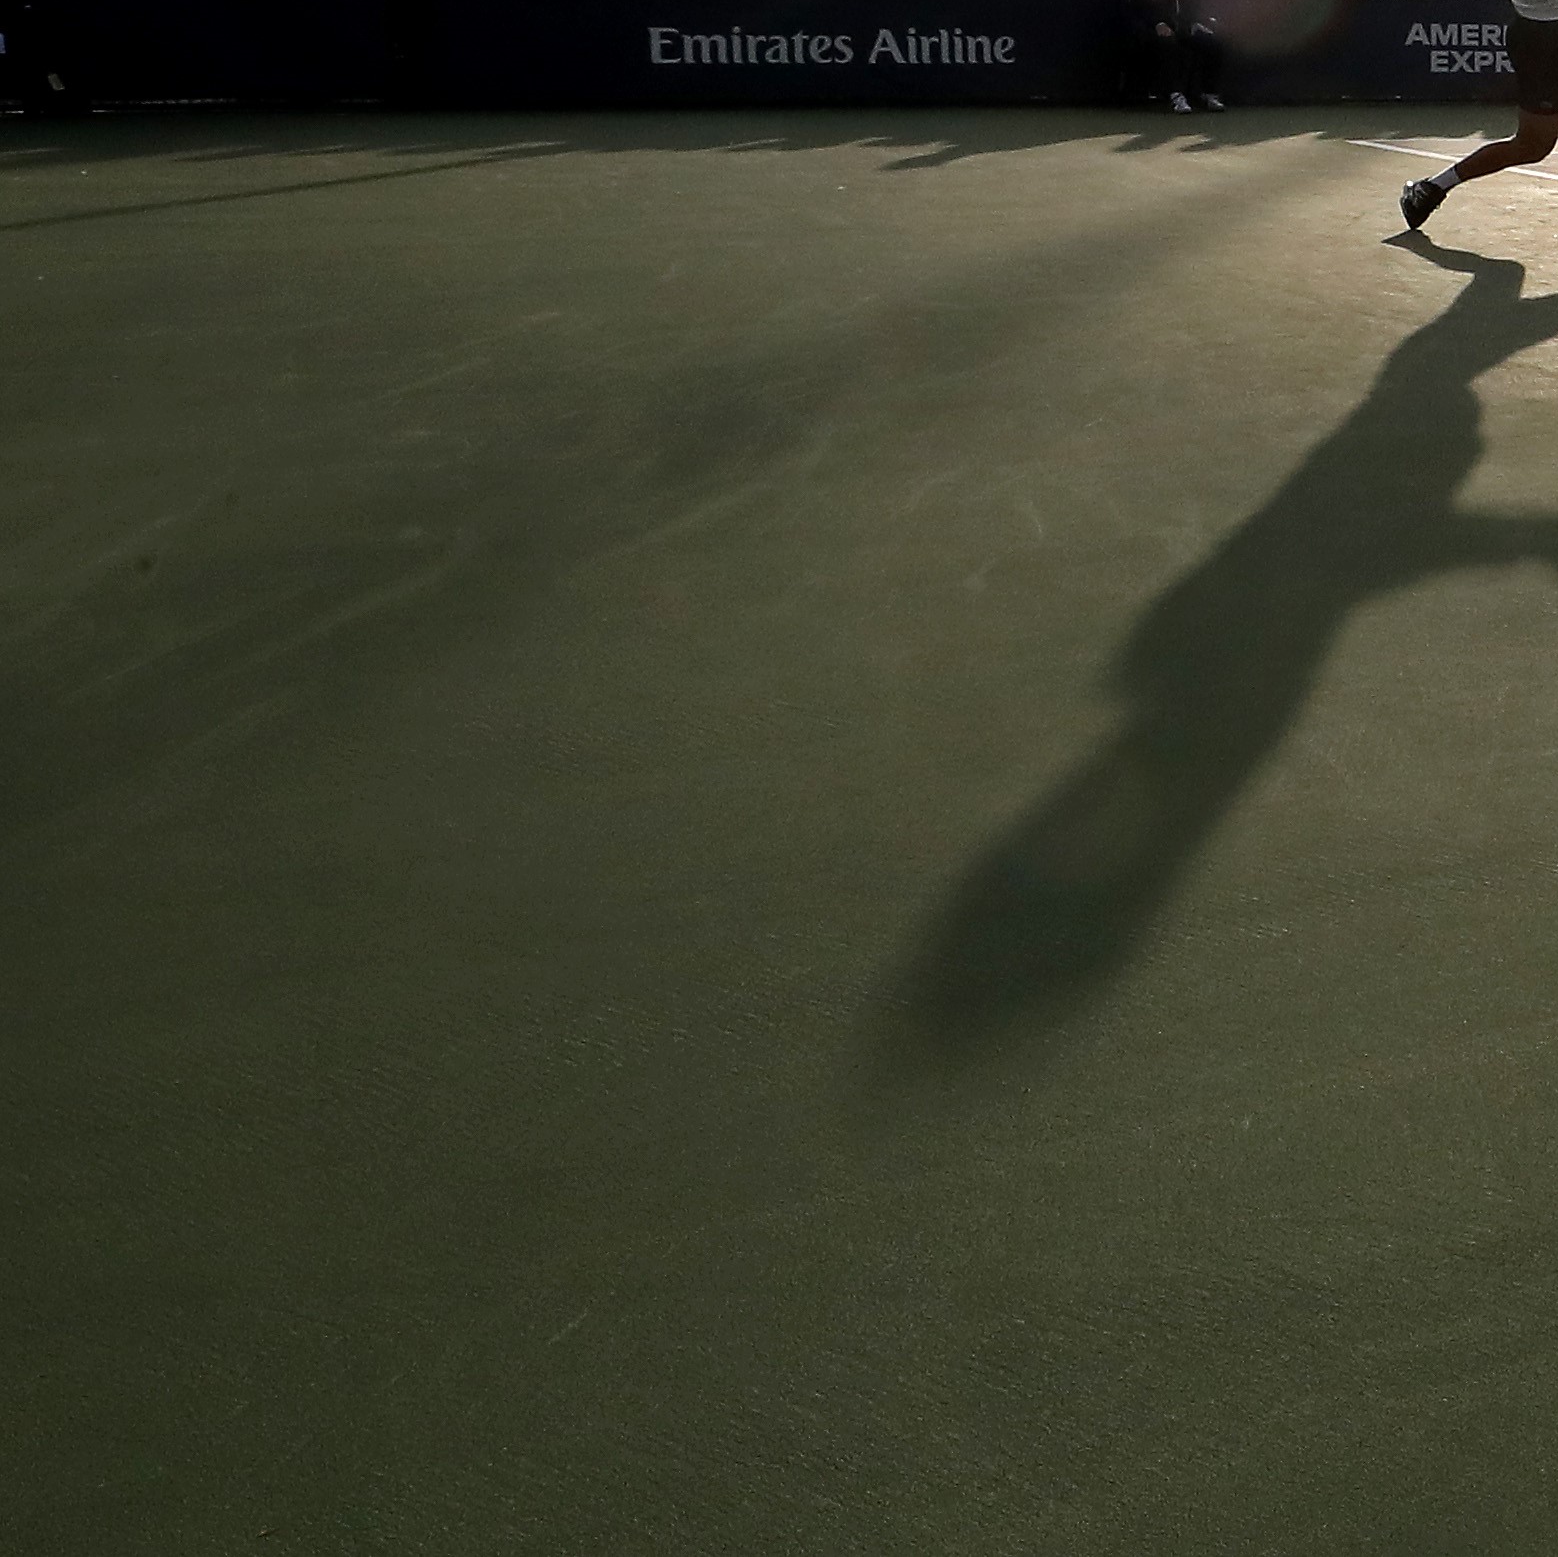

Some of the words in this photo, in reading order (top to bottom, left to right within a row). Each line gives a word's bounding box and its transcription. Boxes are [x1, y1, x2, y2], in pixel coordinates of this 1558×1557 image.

[648, 26, 854, 65] Emirates
[868, 27, 1016, 65] Airline
[1430, 50, 1515, 73] EXPR
